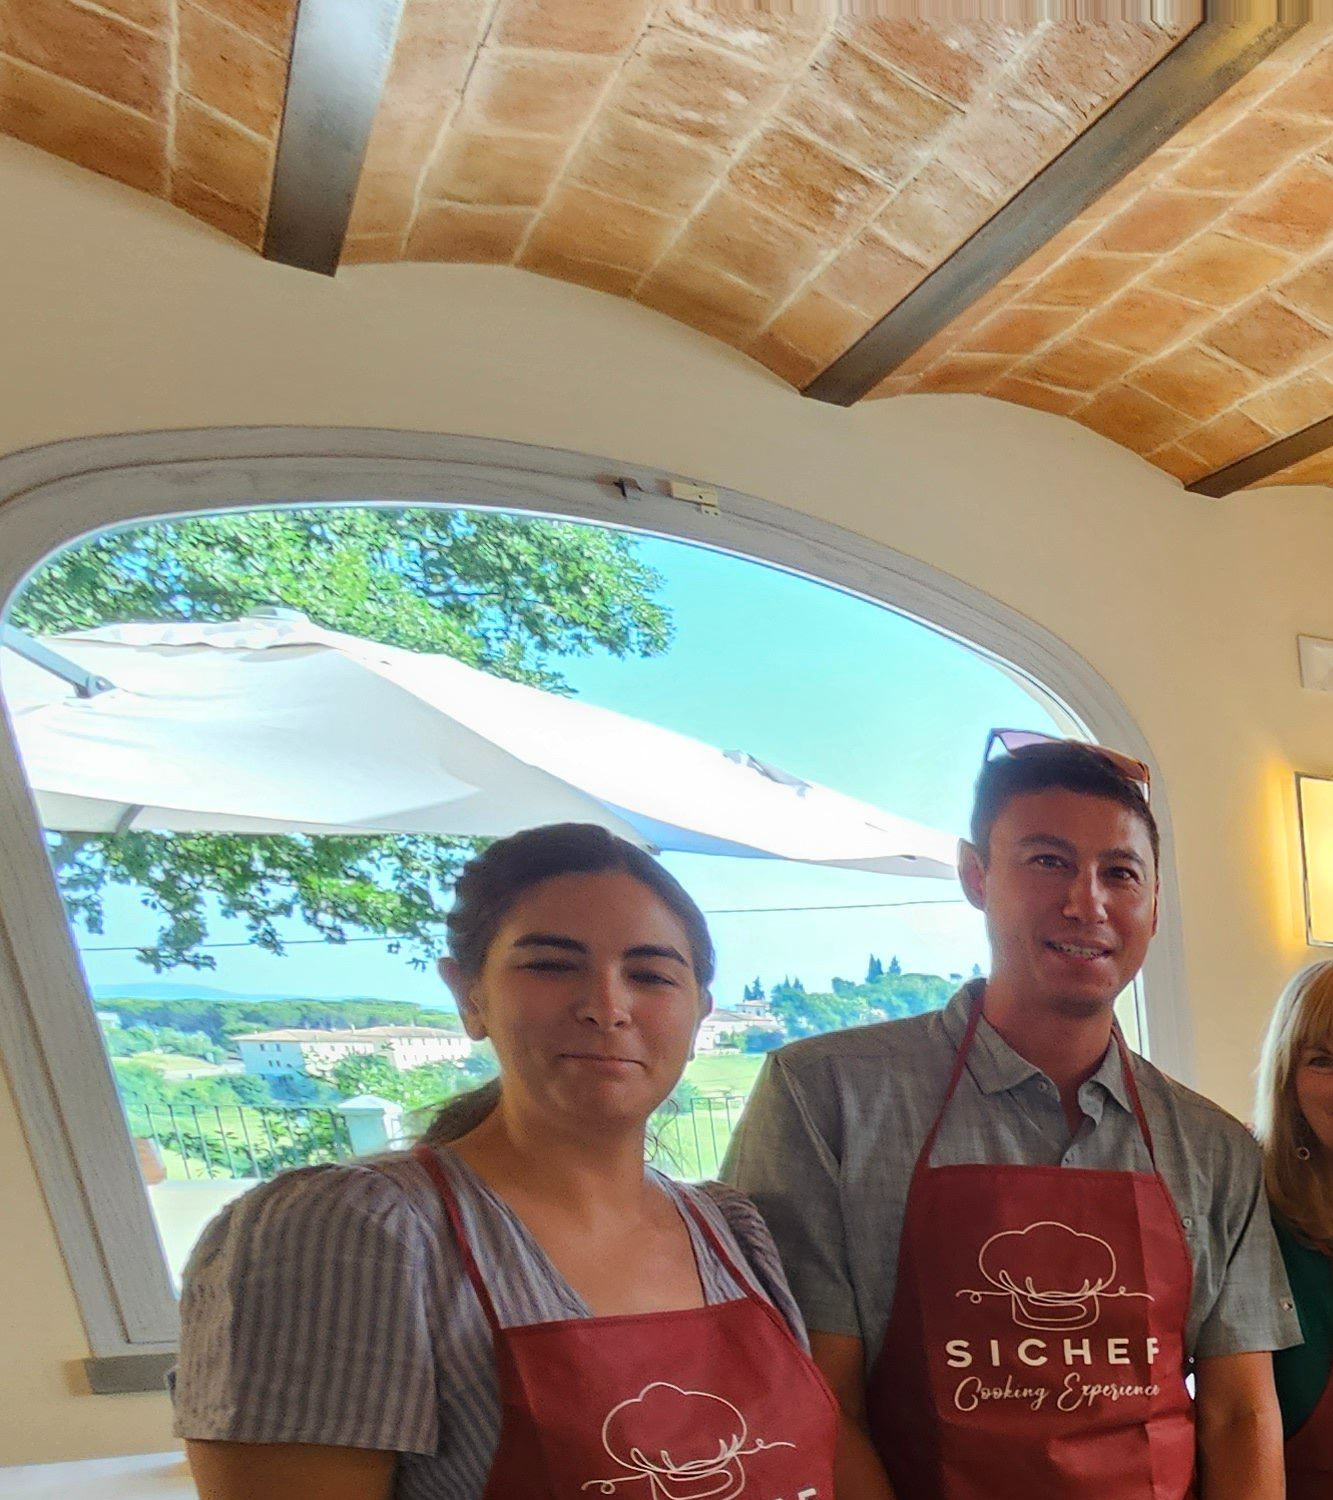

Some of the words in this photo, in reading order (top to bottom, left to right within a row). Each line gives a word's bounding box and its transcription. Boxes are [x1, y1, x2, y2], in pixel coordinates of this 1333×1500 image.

[945, 1337, 1160, 1368] SICHEF
[954, 1374, 1049, 1412] Cooking
[1056, 1371, 1160, 1413] Experience
